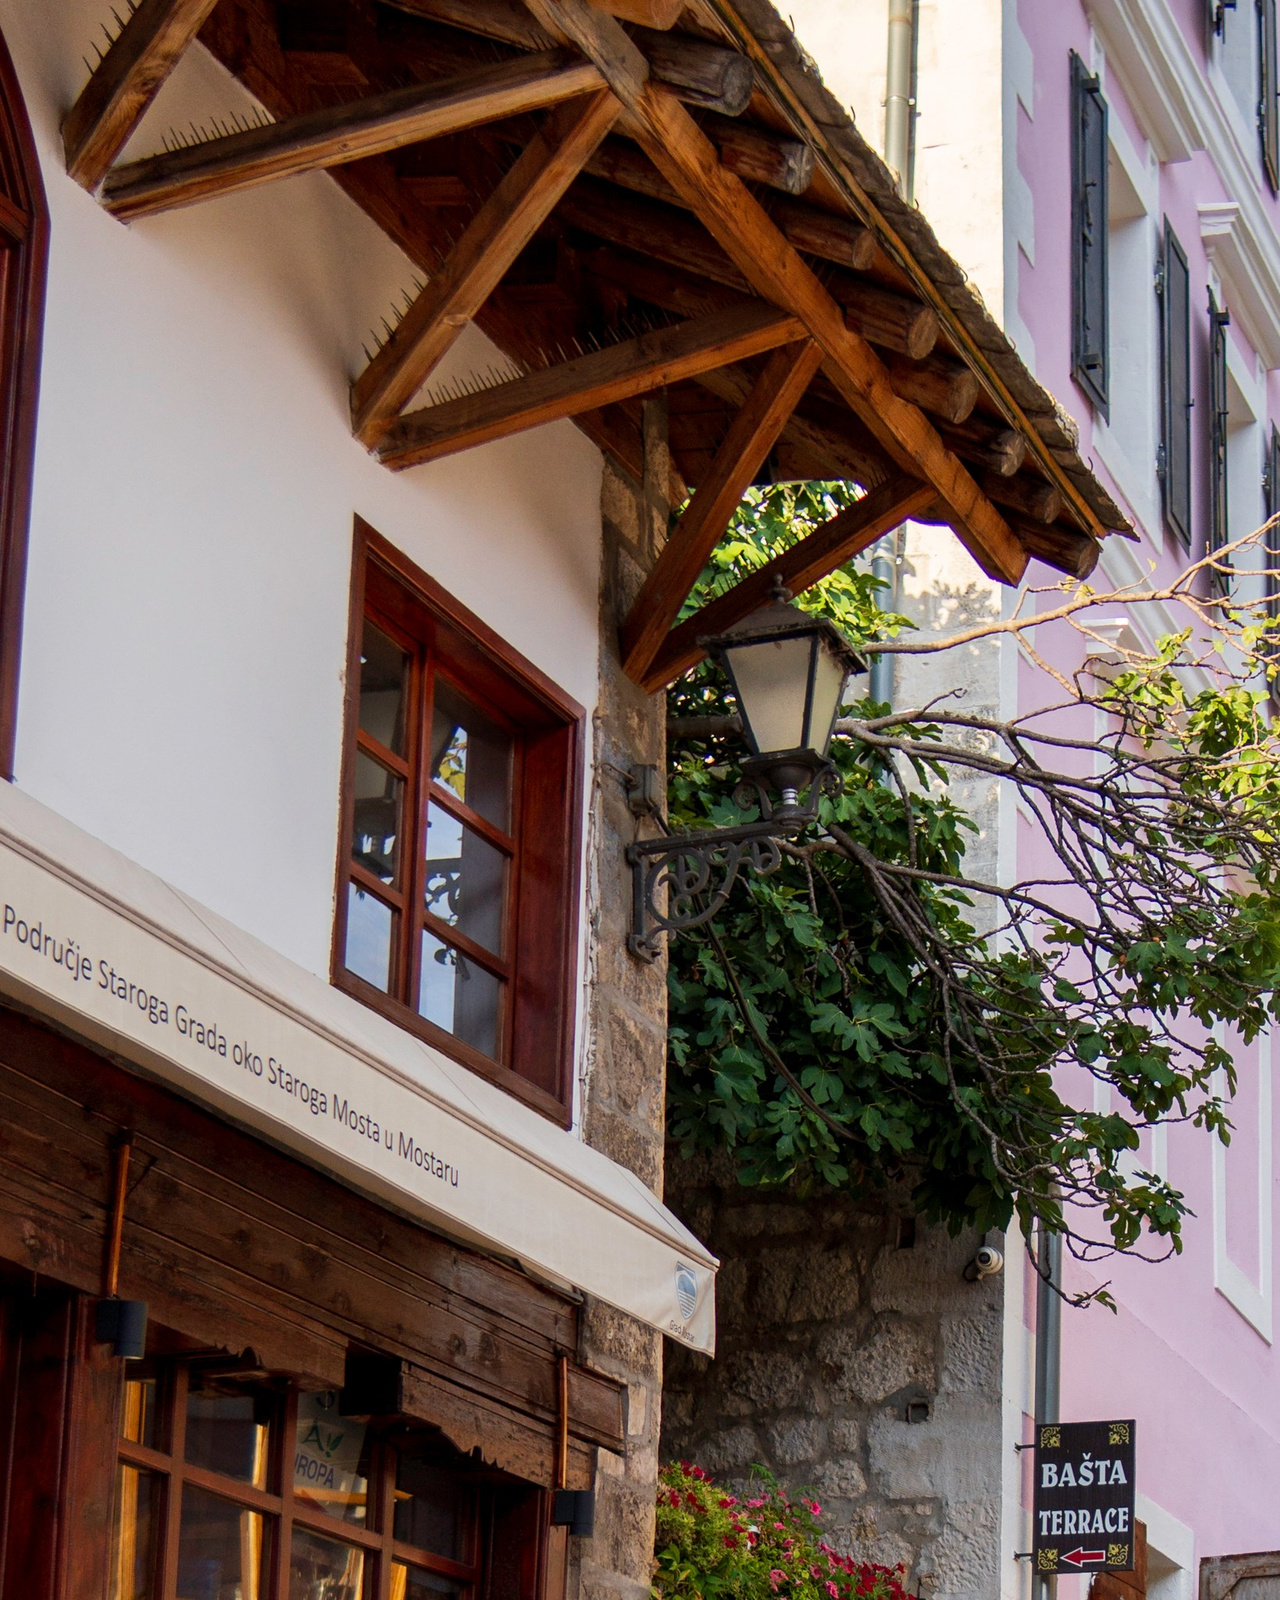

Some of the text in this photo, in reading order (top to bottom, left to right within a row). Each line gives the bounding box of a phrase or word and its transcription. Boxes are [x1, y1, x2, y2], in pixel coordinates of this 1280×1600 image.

[4, 904, 459, 1188] Područje Staroga Grada oko Staroga Mosta u Mostaru
[1041, 1452, 1128, 1488] BAŠTA
[1039, 1507, 1129, 1536] TERRACE
